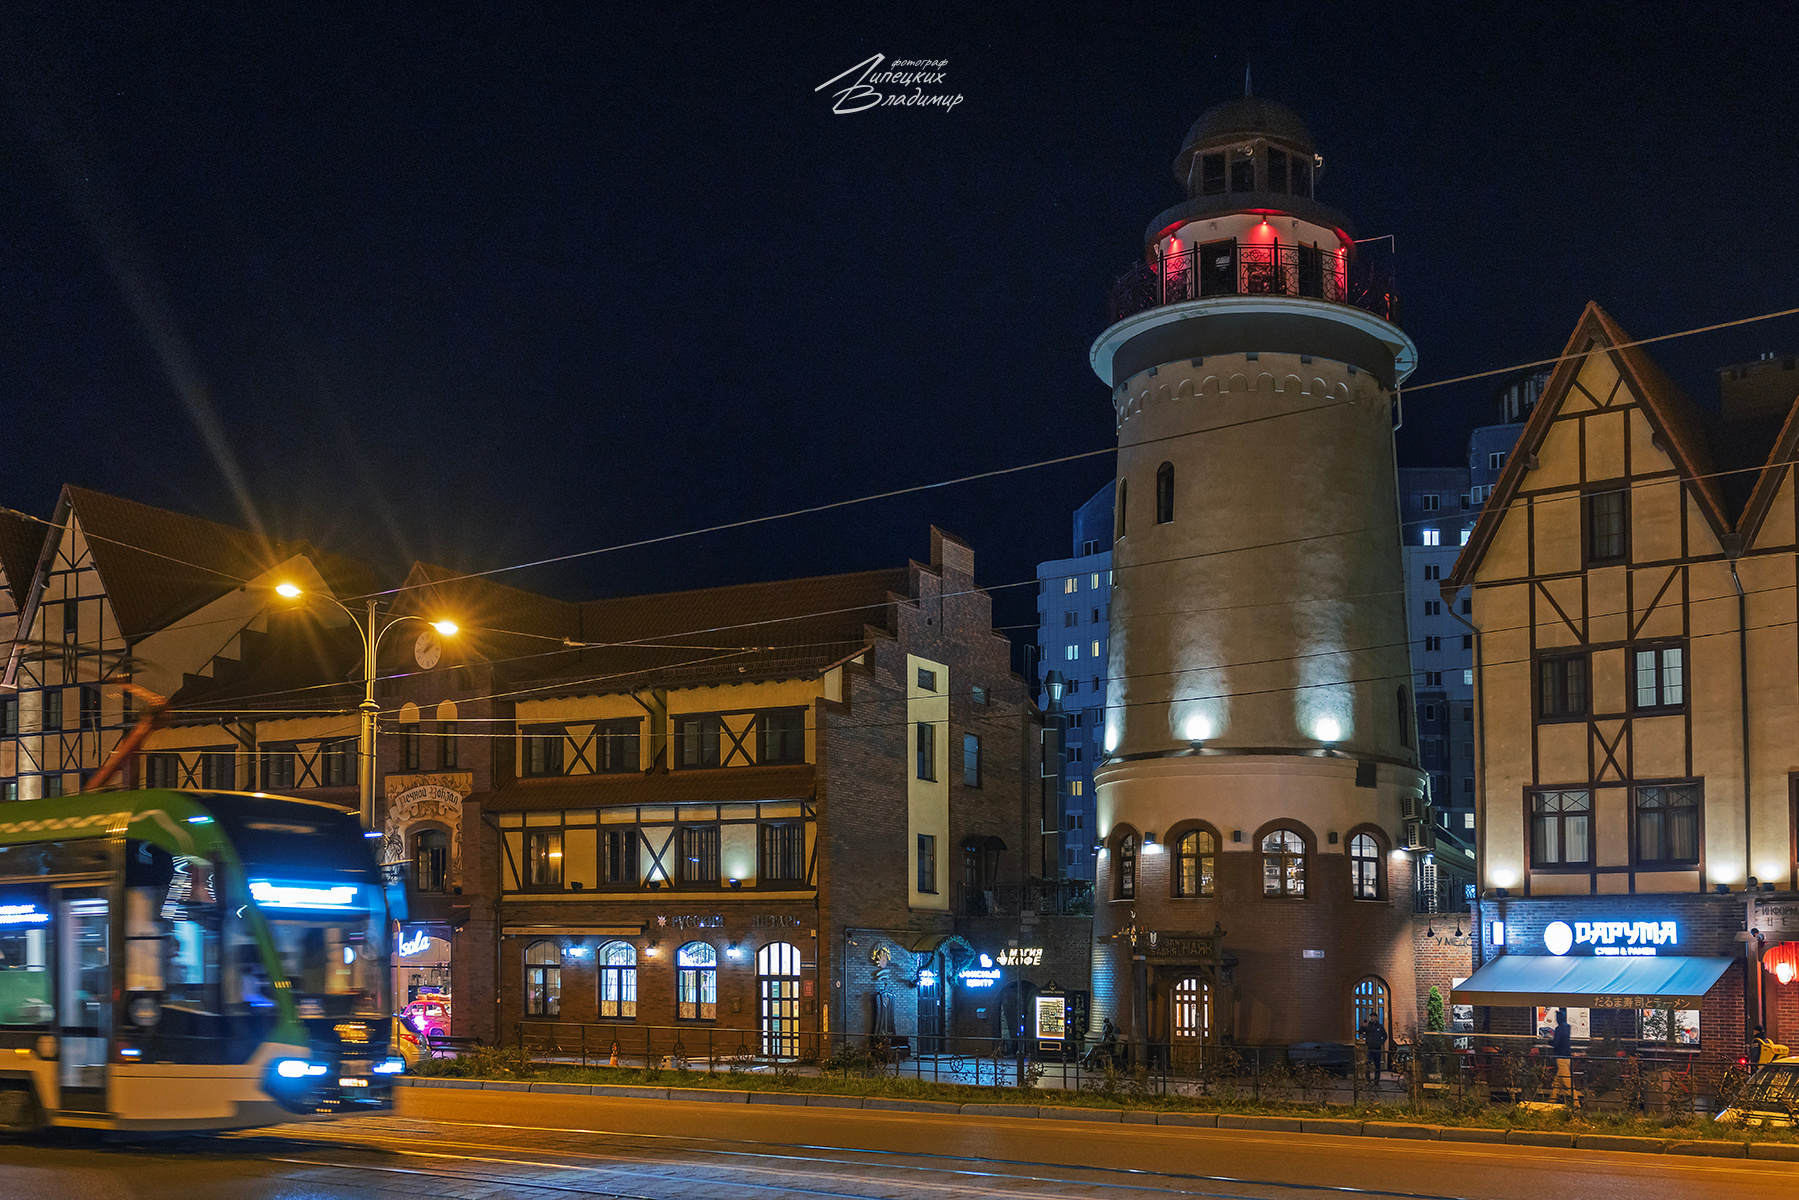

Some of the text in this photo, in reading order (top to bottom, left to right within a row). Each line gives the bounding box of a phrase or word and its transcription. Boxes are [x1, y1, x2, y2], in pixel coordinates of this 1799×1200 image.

[672, 913, 724, 930] РУССКИЙ
[398, 929, 431, 957] Isola
[1181, 941, 1213, 956] МАЯК
[1007, 956, 1042, 966] КОФЕ
